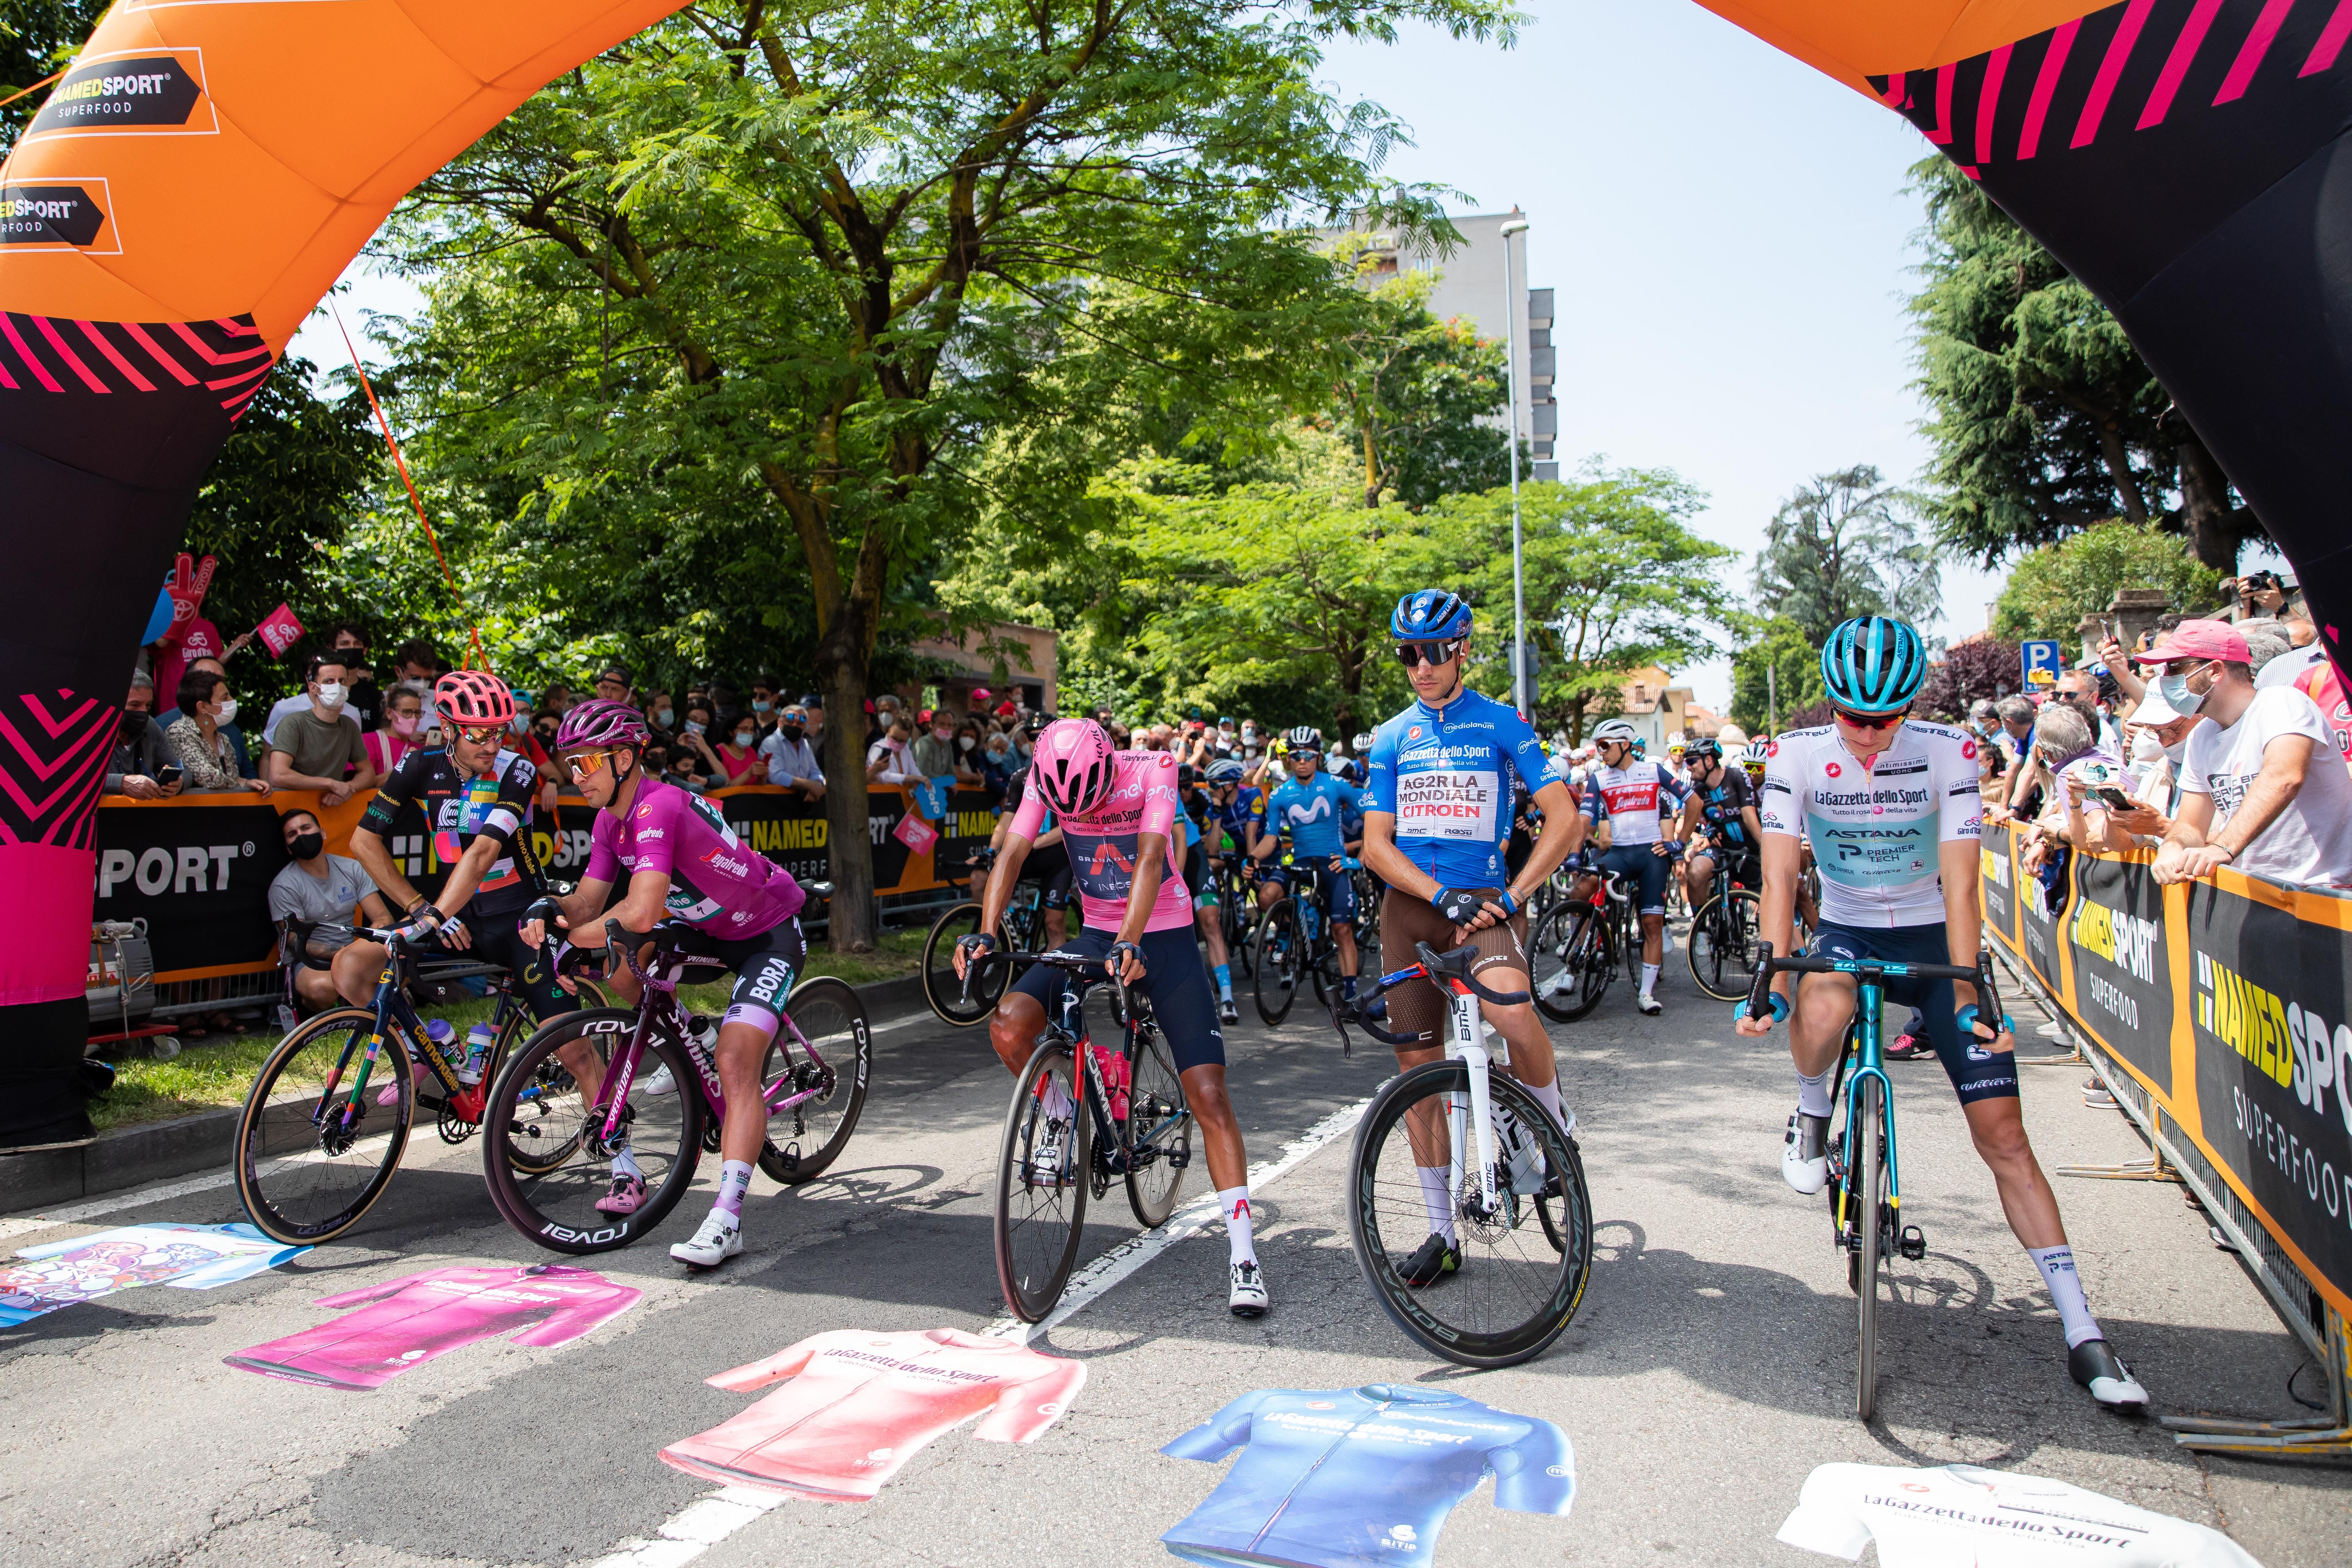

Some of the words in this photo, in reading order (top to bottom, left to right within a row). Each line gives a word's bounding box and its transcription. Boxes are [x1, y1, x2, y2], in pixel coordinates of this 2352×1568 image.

[58, 102, 132, 118] SUPERFOOD
[194, 562, 214, 595] TOYOTA
[2029, 643, 2051, 670] P
[596, 726, 624, 744] SPECIALIZED
[1443, 722, 1495, 734] mediolanum
[1090, 729, 1104, 758] KASK
[1439, 745, 1462, 758] dello
[1464, 744, 1490, 759] Sport
[1877, 758, 1926, 769] intimissimi
[1404, 775, 1448, 790] AG2R
[1452, 775, 1479, 788] LA
[1399, 790, 1487, 803] MONDIALE
[1872, 790, 1897, 804] dello
[1898, 788, 1928, 806] Sport
[367, 806, 393, 824] NIPPO
[1101, 812, 1123, 824] dello
[1403, 803, 1480, 818] CITROËN
[1824, 828, 1923, 838] ASTANA
[517, 828, 536, 875] cannondale
[1867, 844, 1916, 856] PREMIER
[1867, 854, 1900, 862] TECH
[699, 847, 749, 878] Segafredo
[714, 869, 732, 880] ZANETTI
[684, 955, 720, 964] SPECIALIZED
[749, 958, 790, 1003] BORA
[771, 972, 794, 1011] hansgrohe
[2089, 972, 2139, 1030] SUPERFOOD
[1457, 999, 1472, 1041] BMC
[414, 1025, 460, 1091] cannondale
[667, 1008, 722, 1098] S-WORKS
[853, 1017, 868, 1089] roval
[608, 1060, 632, 1126] SPECIALIZED
[1961, 1078, 2012, 1092] Wilier
[541, 1222, 628, 1245] roval
[898, 1363, 945, 1376] dello
[945, 1370, 1001, 1382] Sport
[1355, 1423, 1411, 1436] dello
[1406, 1428, 1473, 1445] Sport
[853, 1459, 886, 1468] SITIP
[1980, 1516, 2045, 1533] dello
[2049, 1525, 2133, 1549] Sport
[1381, 1537, 1418, 1551] SITIP
